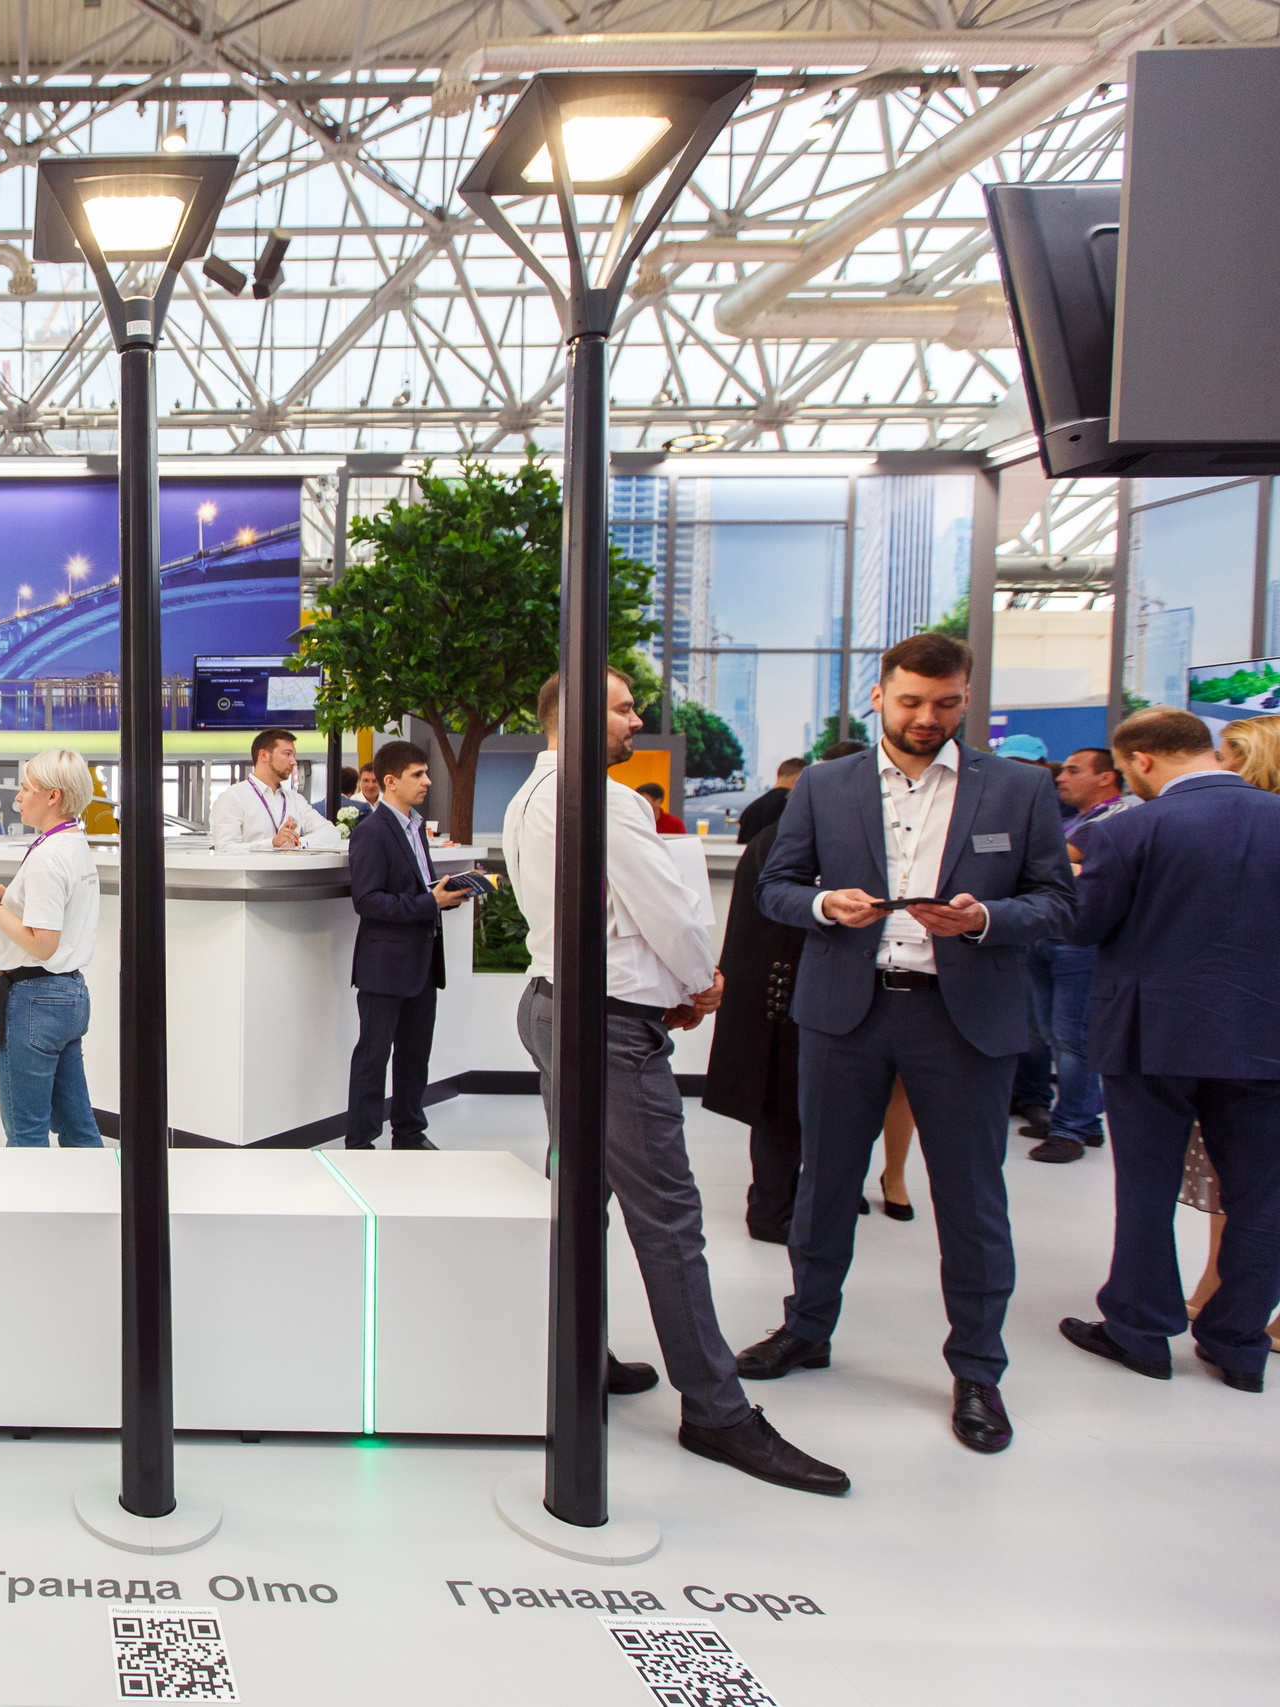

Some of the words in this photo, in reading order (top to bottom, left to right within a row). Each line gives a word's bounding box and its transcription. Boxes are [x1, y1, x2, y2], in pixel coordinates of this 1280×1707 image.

[208, 1575, 339, 1604] Olmo
[446, 1580, 667, 1614] Гранада
[683, 1584, 827, 1621] Copa
